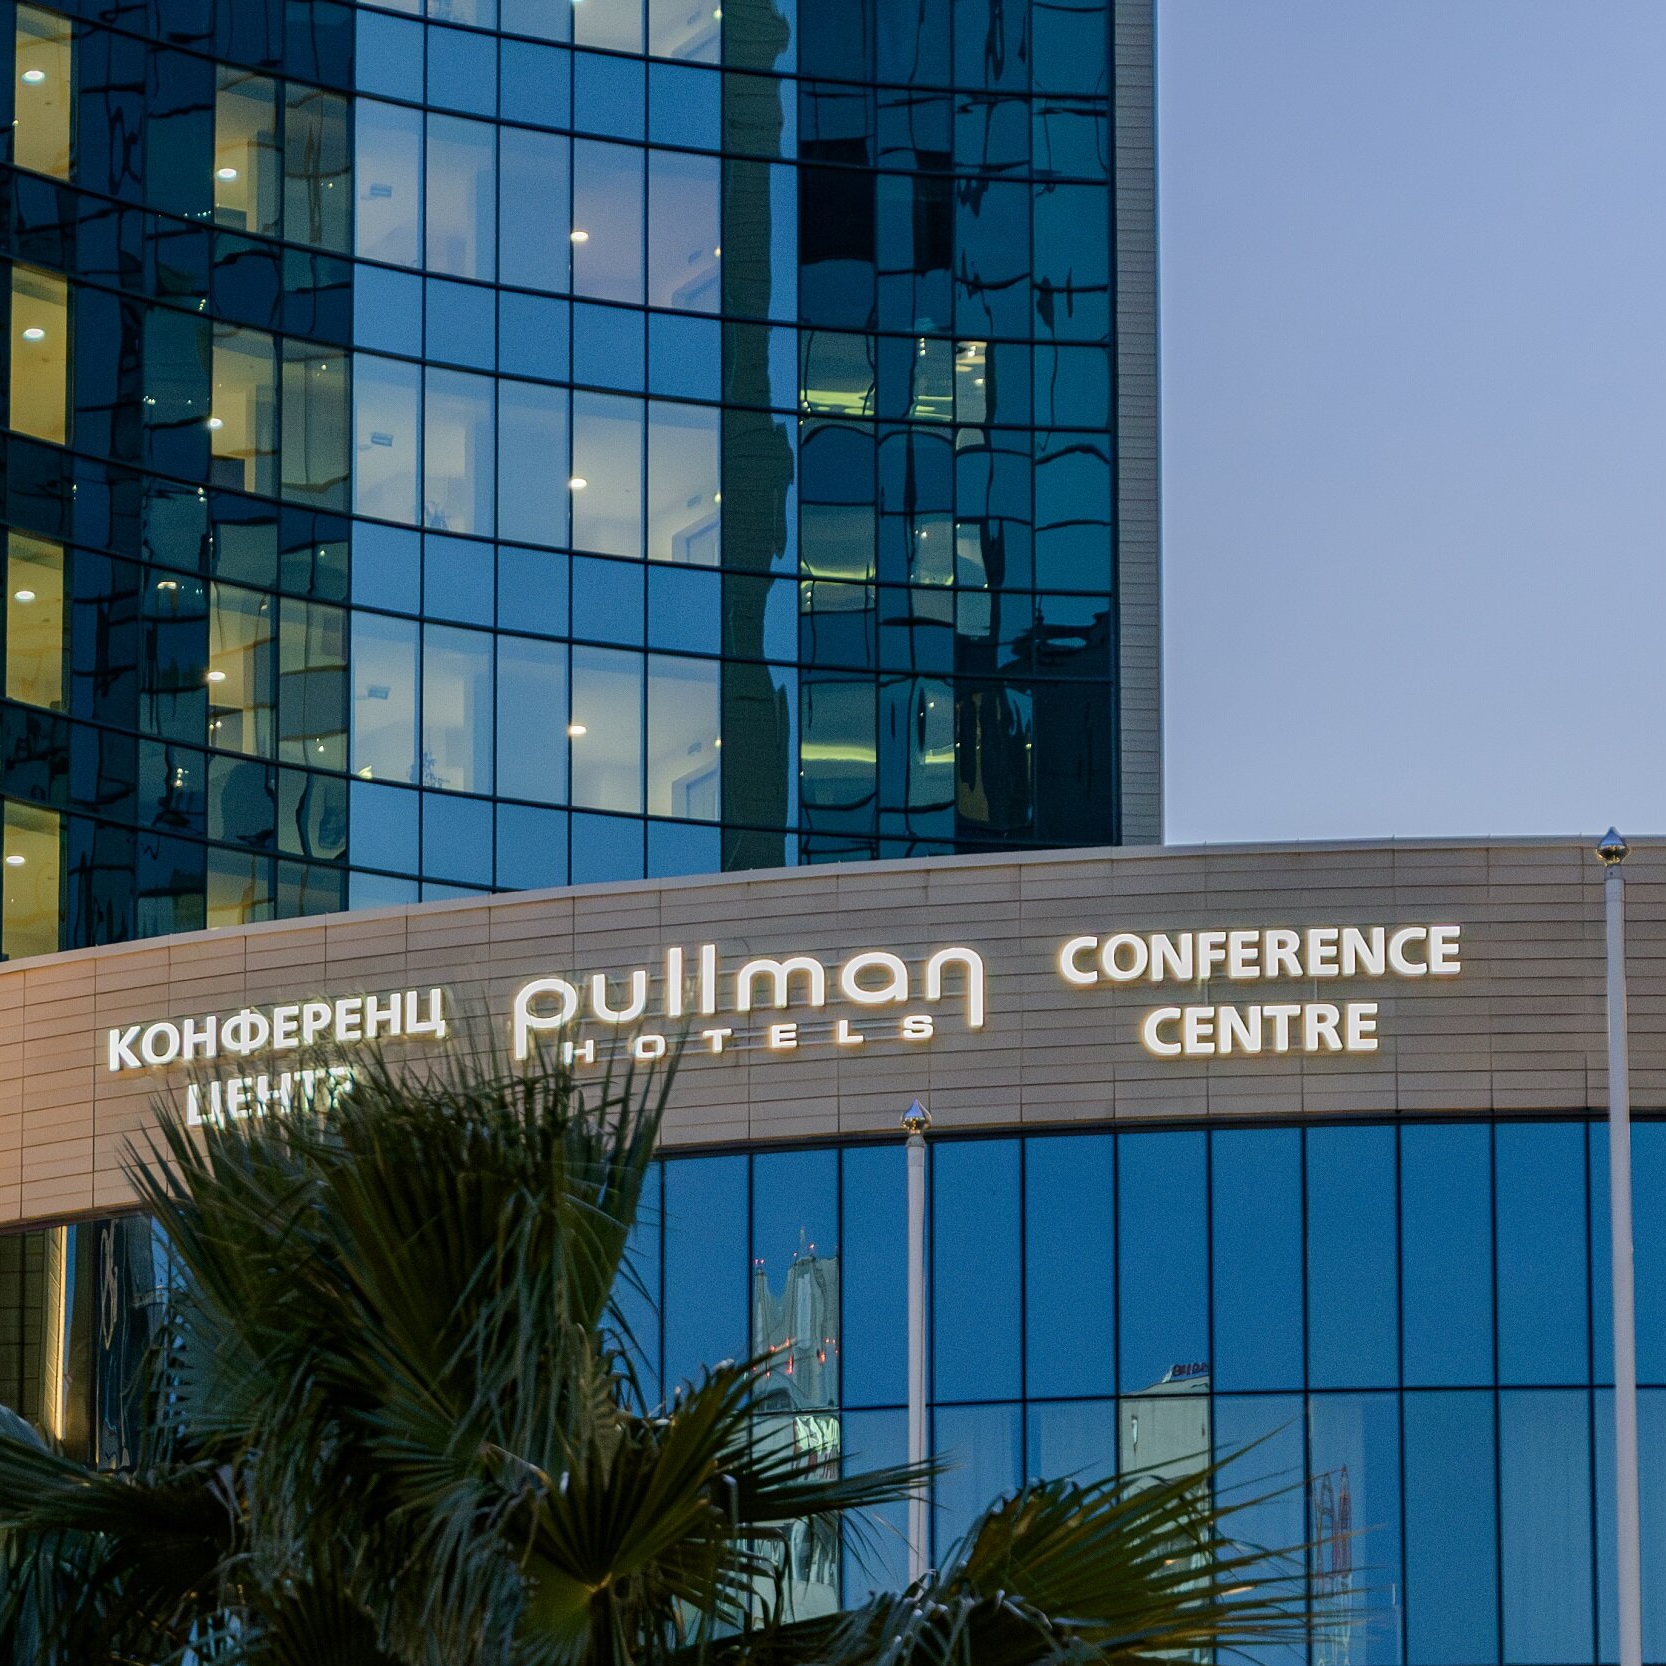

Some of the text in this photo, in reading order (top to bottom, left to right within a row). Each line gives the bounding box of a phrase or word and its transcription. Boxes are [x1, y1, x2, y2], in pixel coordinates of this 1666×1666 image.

[1060, 925, 1462, 984] CONFERENCE
[108, 988, 447, 1072] КОНФЕРЕНЦ
[513, 943, 985, 1061] pullman
[1143, 1002, 1379, 1056] CENTRE
[563, 1014, 934, 1065] HOTELS
